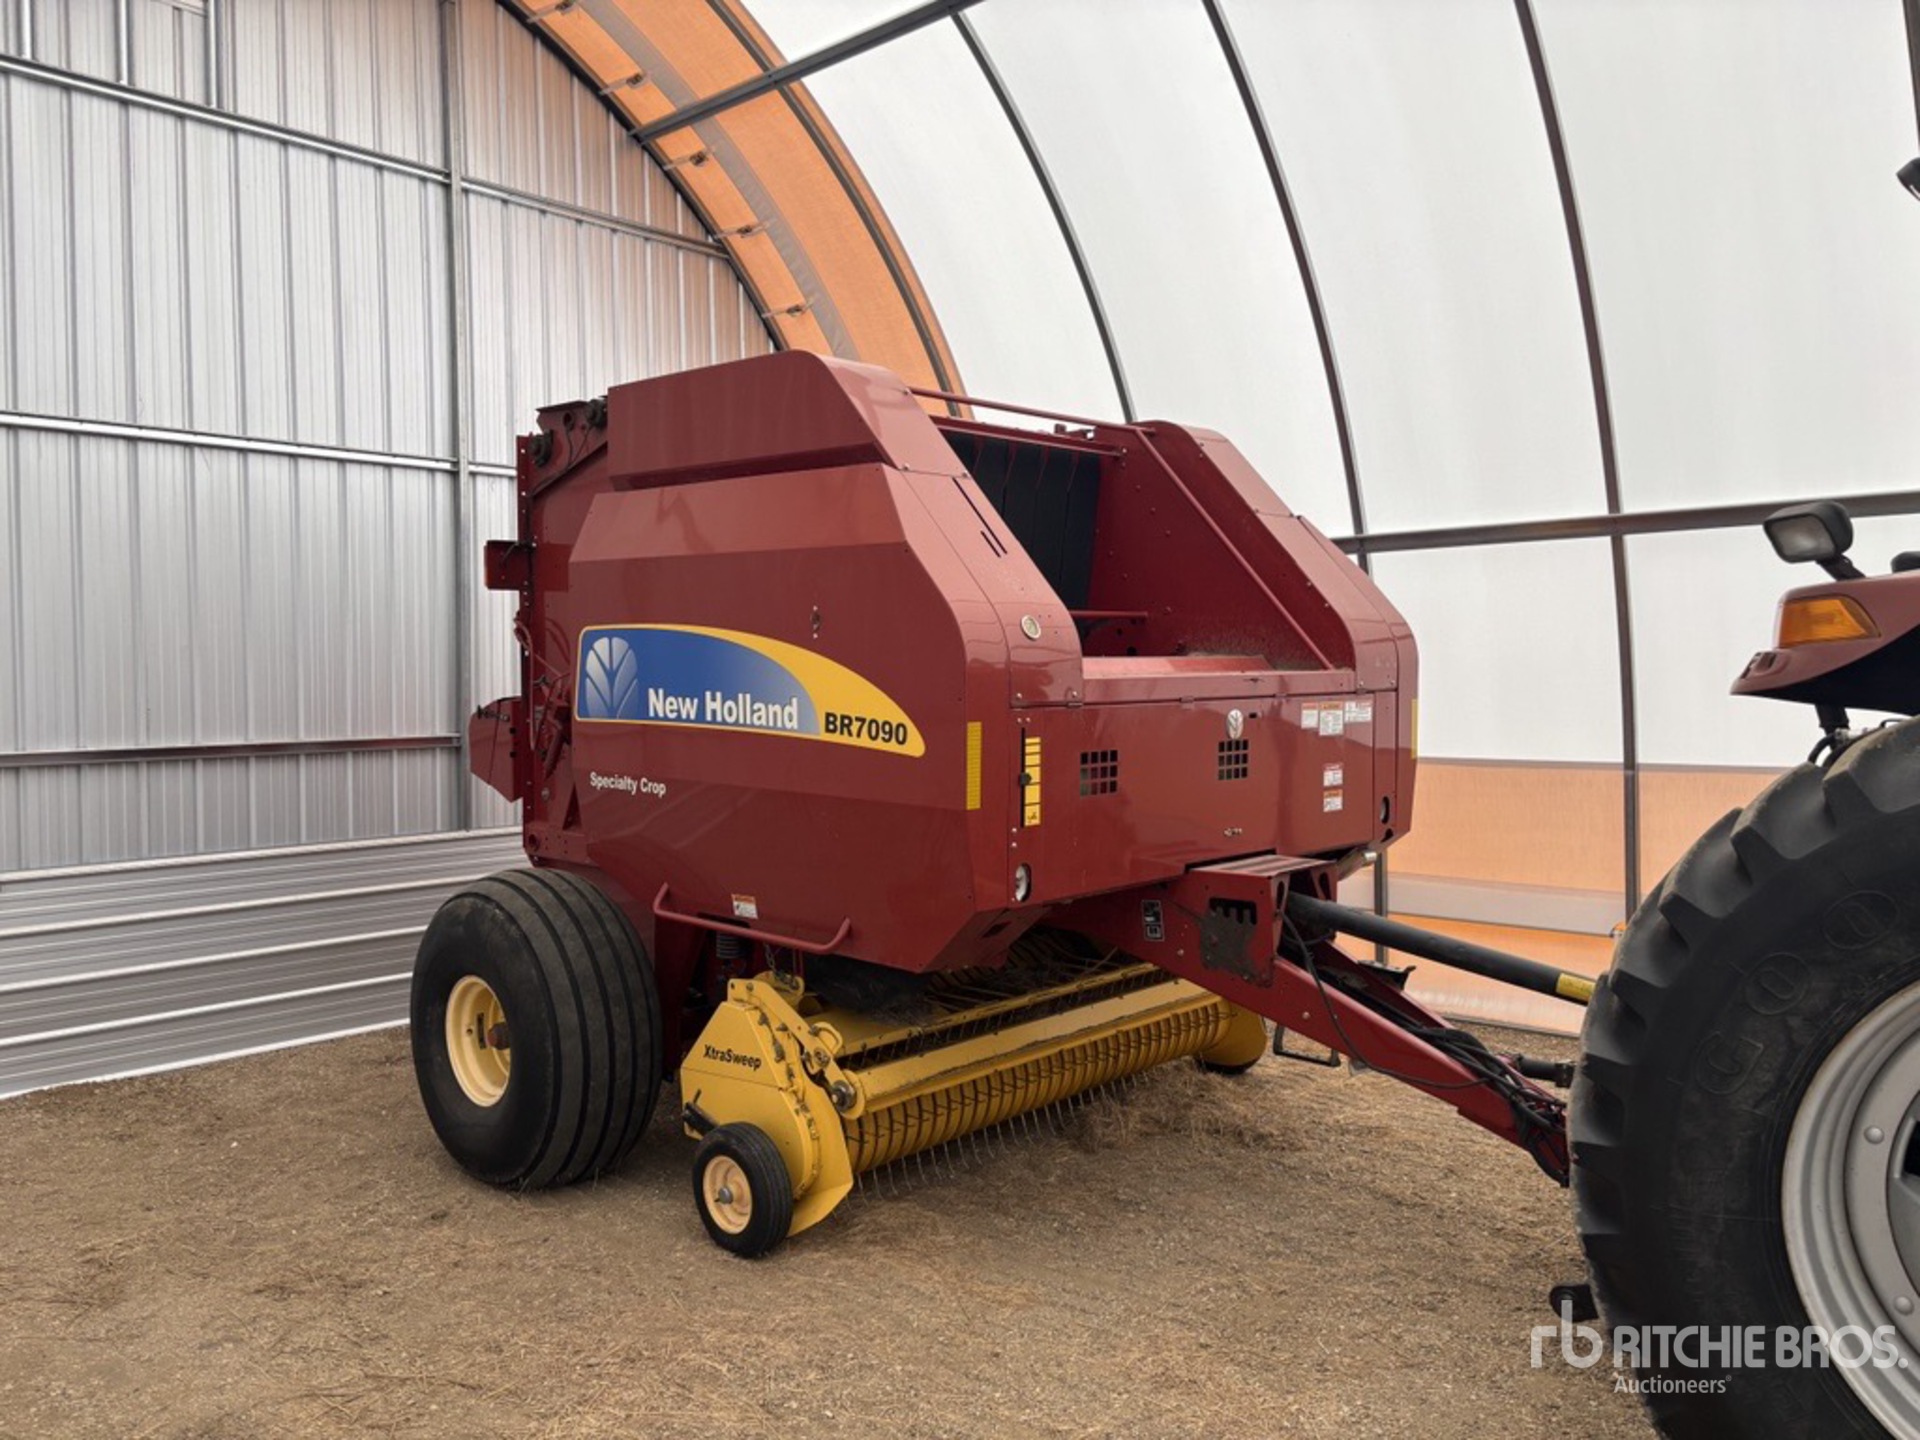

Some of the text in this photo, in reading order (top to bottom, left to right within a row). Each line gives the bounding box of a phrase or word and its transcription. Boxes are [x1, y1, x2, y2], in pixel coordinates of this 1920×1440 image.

[648, 687, 799, 730] New Holland
[824, 711, 908, 746] BR7090
[590, 771, 667, 798] Specialty Crop
[703, 1044, 762, 1071] XtraSweep
